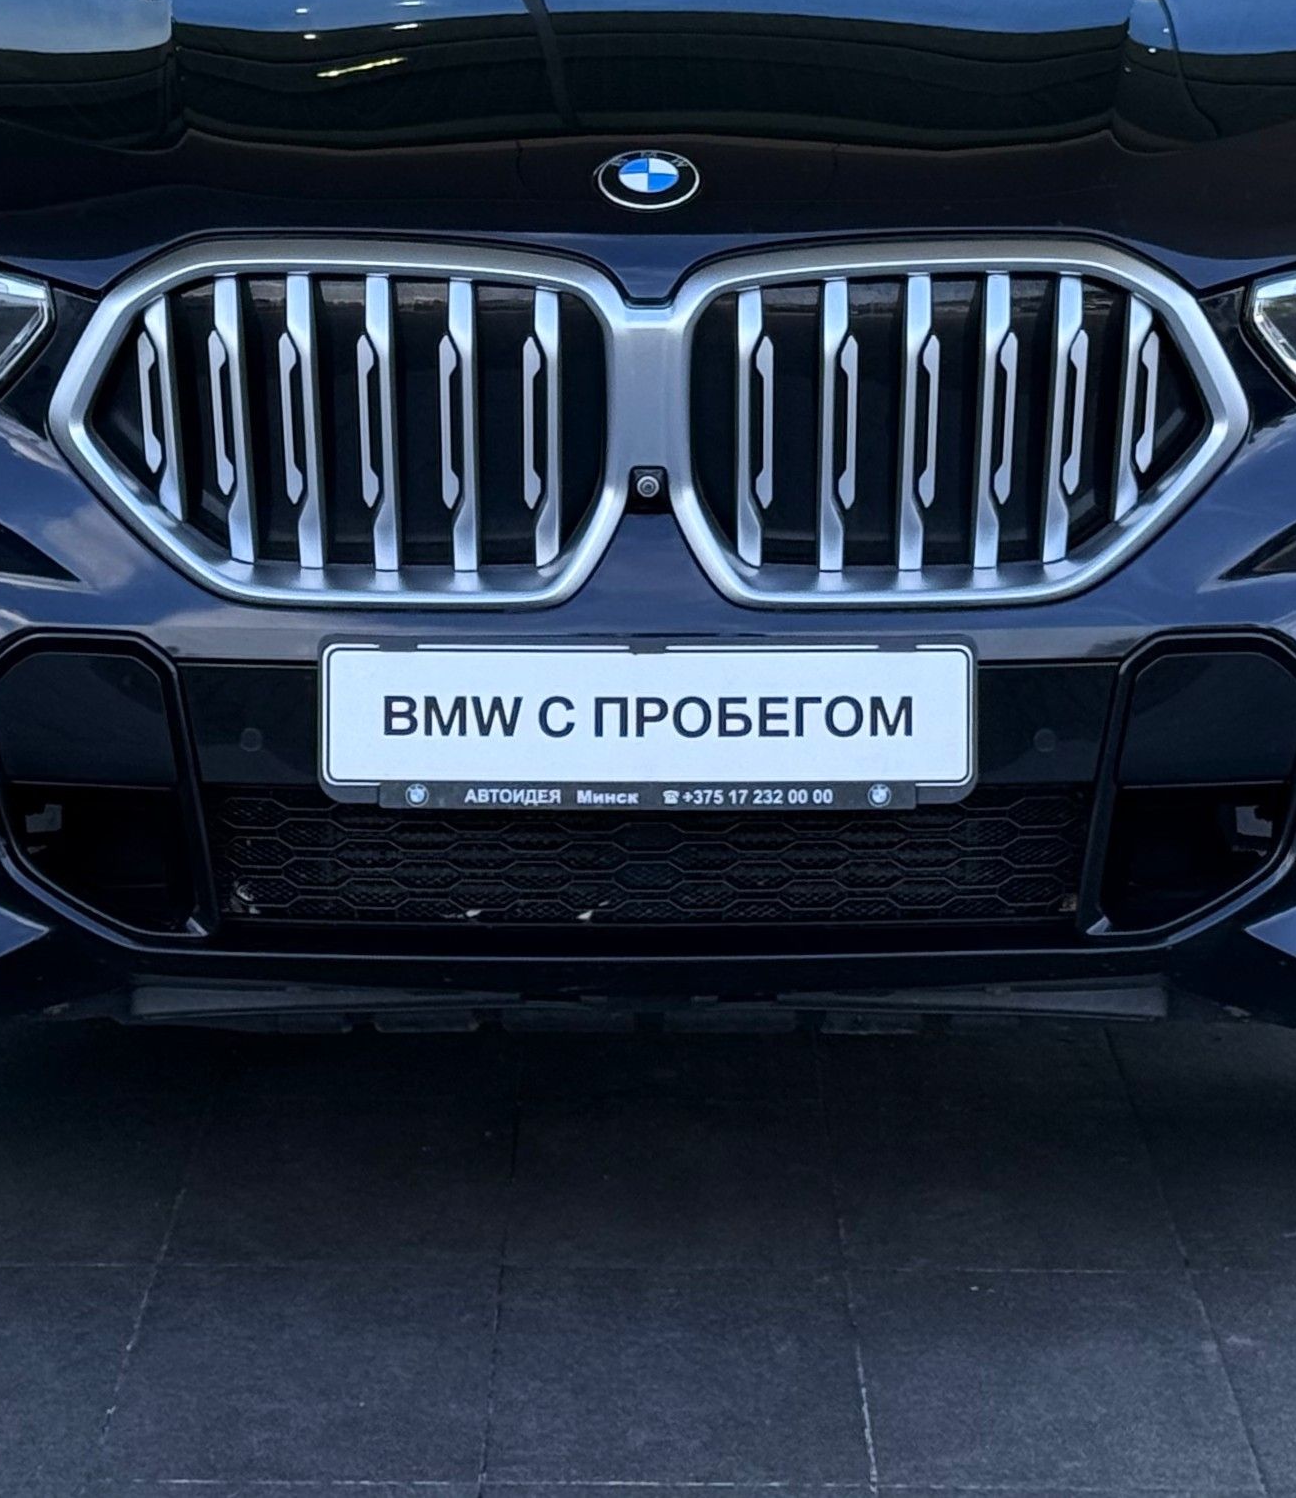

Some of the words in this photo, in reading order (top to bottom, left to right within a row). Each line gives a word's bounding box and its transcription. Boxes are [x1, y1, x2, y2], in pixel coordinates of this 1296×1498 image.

[382, 695, 523, 738] BMW
[538, 695, 575, 738] С
[594, 695, 913, 738] ПРОБЕГОМ
[464, 788, 562, 806] АВТОИДЕЯ
[576, 789, 639, 804] Минск
[682, 789, 724, 804] +375
[728, 789, 748, 804] 17
[752, 789, 783, 804] 232
[787, 788, 808, 804] 00
[812, 788, 833, 804] 00
